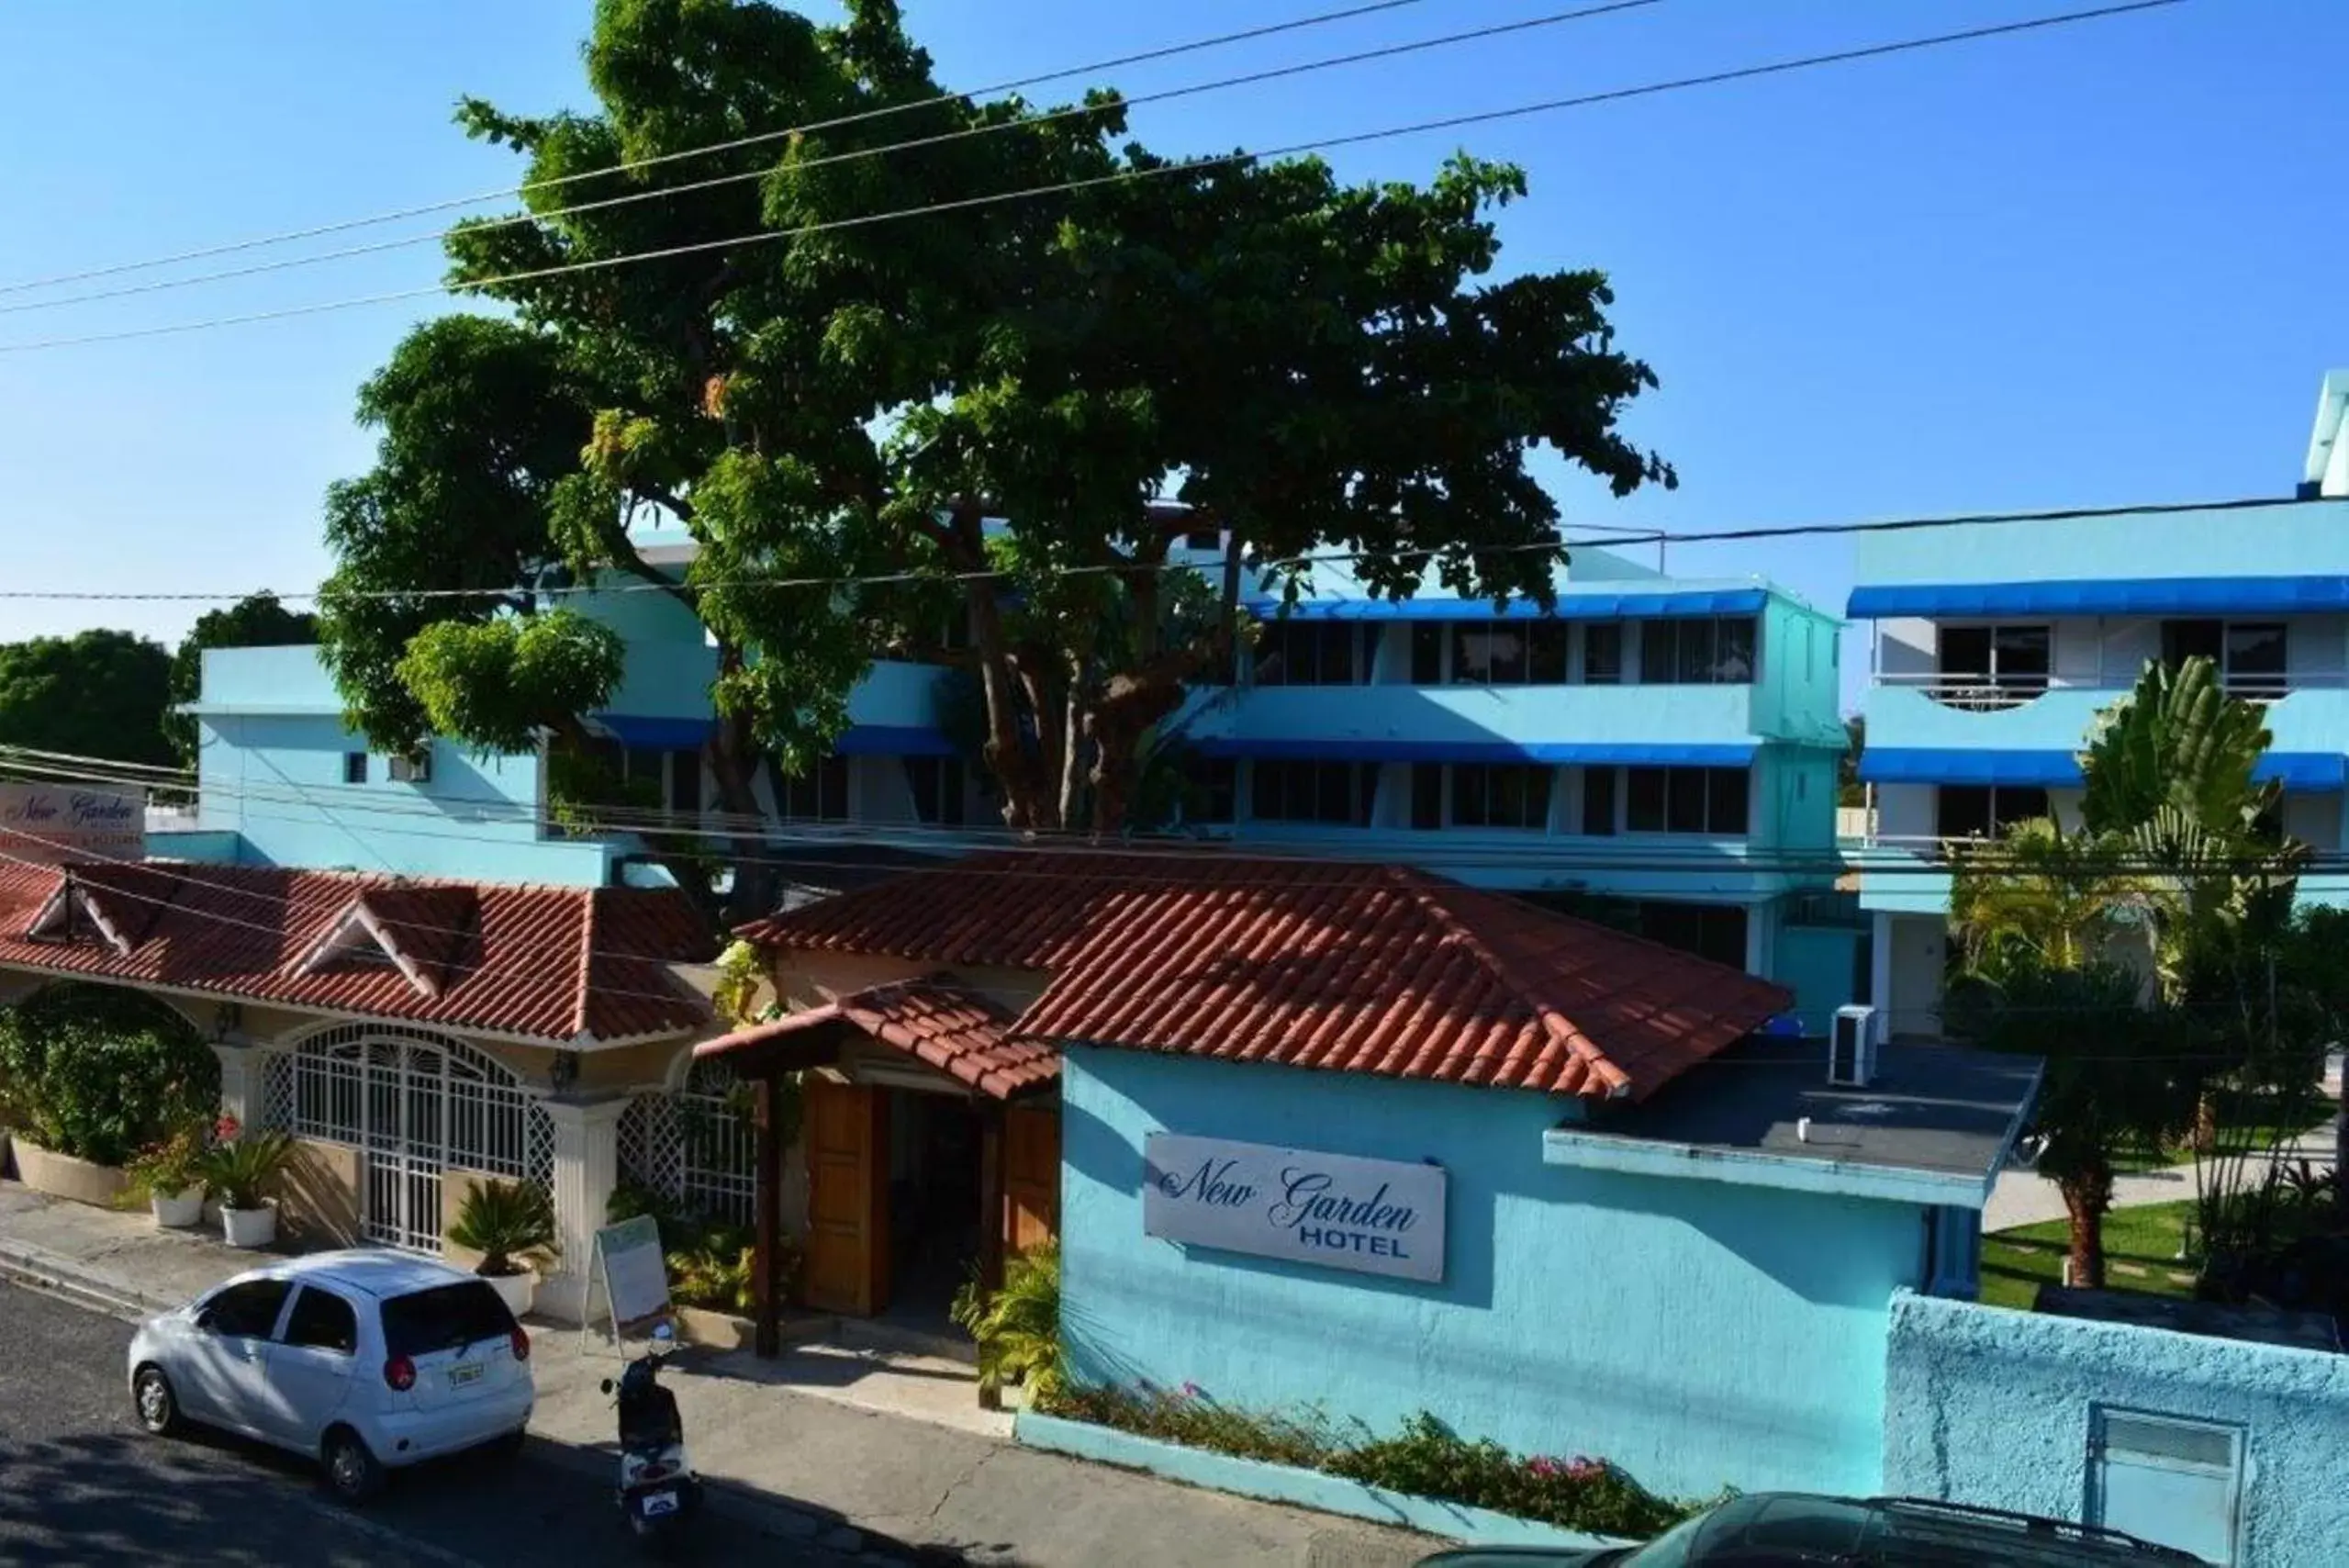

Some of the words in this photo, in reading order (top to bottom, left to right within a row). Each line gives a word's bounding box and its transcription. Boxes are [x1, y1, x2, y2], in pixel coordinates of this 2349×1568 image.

[5, 793, 59, 821] New
[63, 791, 134, 828] Garden
[1159, 1157, 1257, 1207] New
[1268, 1167, 1420, 1232] Garden
[1300, 1226, 1410, 1259] HOTEL
